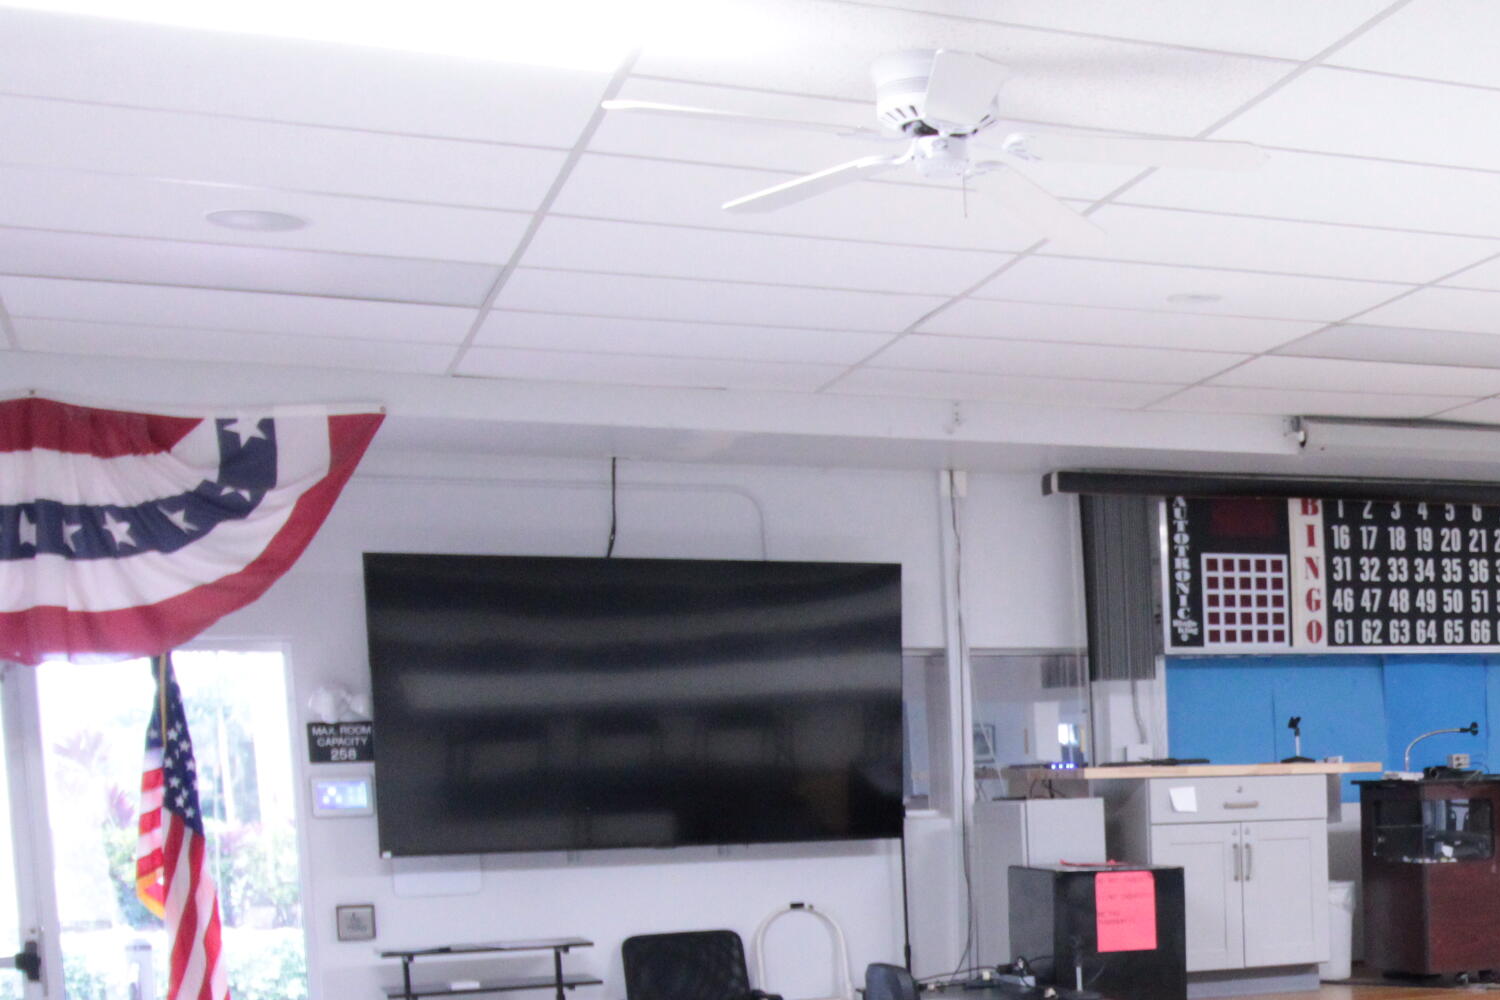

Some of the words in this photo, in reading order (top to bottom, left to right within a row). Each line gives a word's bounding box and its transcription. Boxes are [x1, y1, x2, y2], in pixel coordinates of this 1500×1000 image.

[1363, 501, 1373, 519] 2
[1391, 502, 1401, 520] 3
[1418, 503, 1428, 520] 4
[1445, 504, 1455, 521] 5
[1472, 504, 1482, 522] 6
[1332, 525, 1350, 550] 16
[1360, 526, 1377, 549] 17
[1388, 527, 1406, 551] 18
[1415, 527, 1433, 551] 19
[1441, 528, 1461, 552] 20
[1469, 529, 1486, 552] 21
[1171, 496, 1192, 619] AUTOTRONIC
[1333, 556, 1351, 581] 31
[1360, 557, 1380, 581] 32
[1388, 557, 1408, 582] 33
[1414, 558, 1435, 582] 34
[1442, 558, 1462, 582] 35
[1469, 559, 1489, 583] 36
[1298, 497, 1323, 644] BINGO
[1333, 588, 1354, 612] 46
[1361, 589, 1381, 612] 47
[1389, 589, 1409, 613] 48
[1416, 589, 1436, 613] 49
[1443, 589, 1463, 613] 50
[1471, 589, 1488, 613] 51
[1335, 619, 1353, 644] 61
[1362, 619, 1382, 644] 62
[1390, 619, 1410, 643] 63
[1416, 620, 1437, 644] 64
[1444, 619, 1464, 643] 65
[1471, 620, 1490, 643] 66
[316, 735, 367, 747] CAPACITY
[339, 724, 371, 735] ROOM
